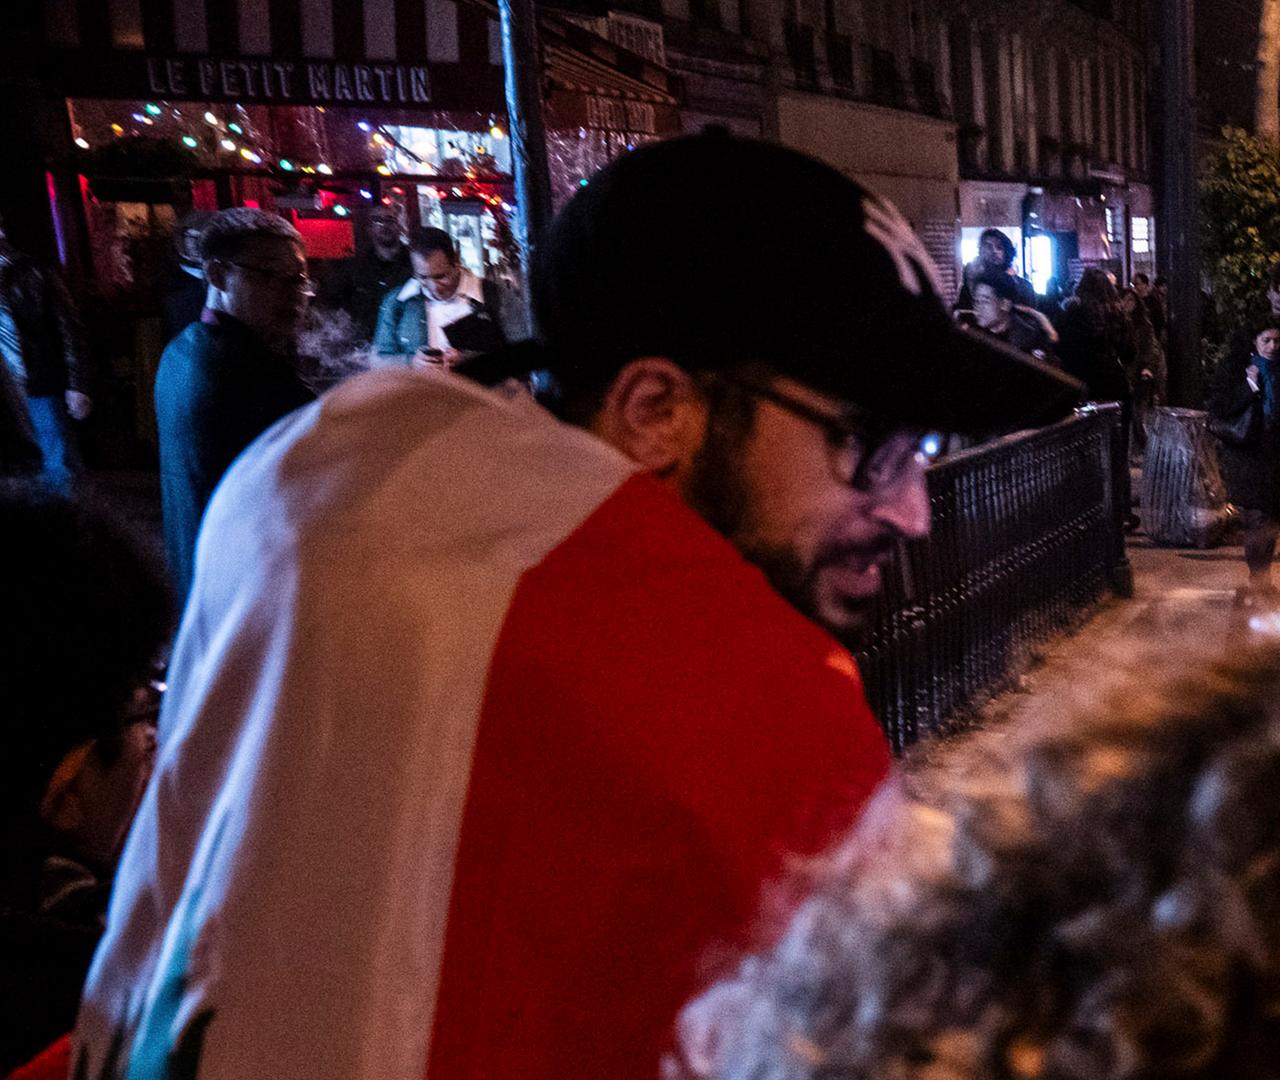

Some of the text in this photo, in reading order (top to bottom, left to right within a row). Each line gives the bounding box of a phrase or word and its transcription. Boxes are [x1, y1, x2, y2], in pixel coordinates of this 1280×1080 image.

[147, 60, 430, 102] LE PETIT MARTIN
